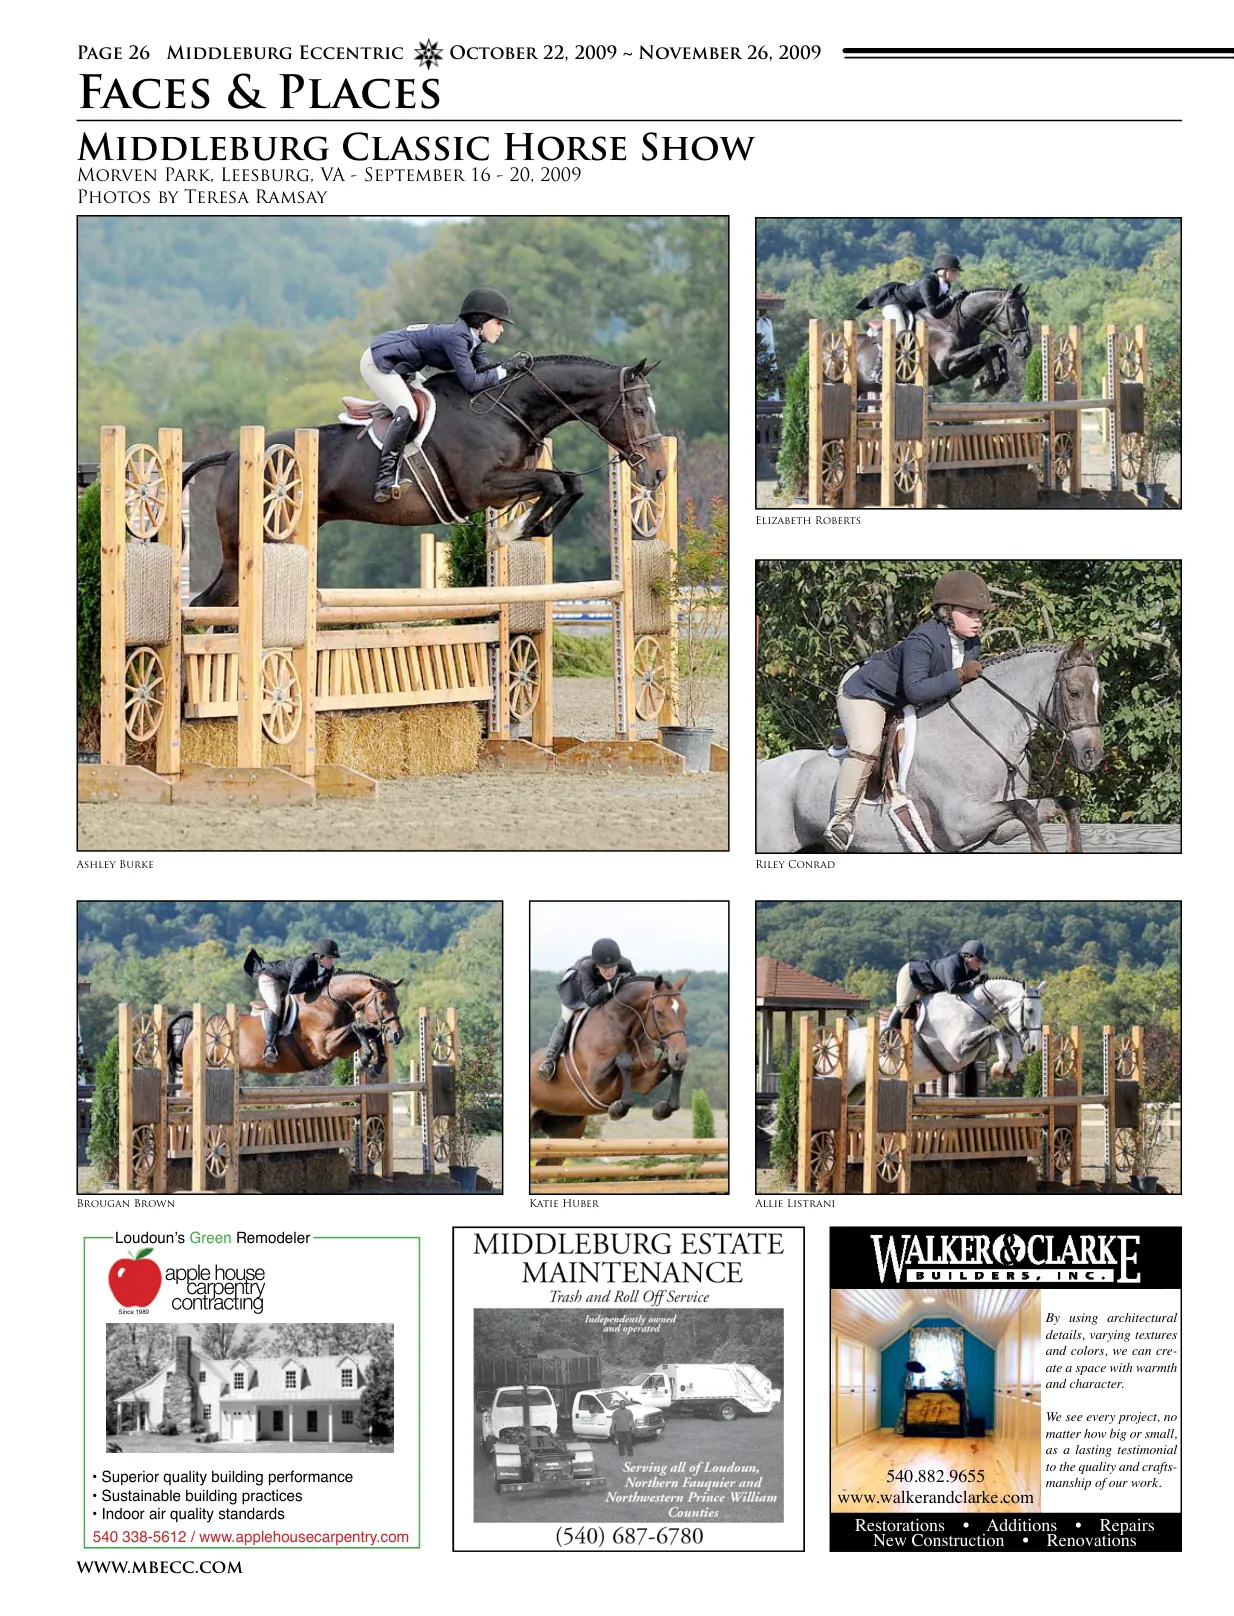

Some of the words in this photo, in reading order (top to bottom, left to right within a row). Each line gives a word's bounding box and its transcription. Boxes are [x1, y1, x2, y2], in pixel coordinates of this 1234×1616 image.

[77, 44, 123, 60] PAGE
[128, 44, 151, 60] 26
[166, 44, 293, 60] MIDDLEBURG
[299, 44, 404, 60] ECCENTRIC
[449, 44, 539, 60] OCTOBER
[542, 44, 569, 62] 22,
[574, 44, 618, 60] 2009
[638, 44, 743, 60] NOVEMBER
[746, 44, 773, 62] 26,
[778, 44, 822, 60] 2009
[78, 73, 210, 110] FACES
[227, 72, 268, 110] &
[278, 73, 440, 110] PLACES
[76, 131, 330, 162] MIDDLEBURG
[342, 131, 490, 162] CLASSIC
[503, 132, 627, 162] HORSE
[641, 131, 756, 162] SHOW
[77, 166, 157, 182] MORVEN
[165, 166, 214, 183] PARK,
[221, 166, 314, 183] LEESBURG,
[319, 166, 346, 182] VA
[364, 166, 466, 182] SEPTEMBER
[471, 166, 491, 182] 16
[509, 166, 534, 183] 20,
[540, 166, 582, 182] 2009
[78, 188, 151, 204] PHOTOS
[158, 190, 179, 204] BY
[183, 188, 250, 204] TERESA
[256, 188, 328, 204] RAMSAY
[756, 515, 811, 525] ELIZABETH
[815, 515, 861, 525] ROBERTS
[76, 859, 116, 869] ASHLEY
[119, 859, 154, 869] BURKE
[756, 859, 786, 869] RILEY
[788, 859, 836, 869] CONRAD
[77, 1198, 130, 1208] BROUGAN
[134, 1198, 175, 1208] BROWN
[529, 1198, 559, 1208] KATIE
[563, 1198, 600, 1208] HUBER
[755, 1198, 784, 1208] ALLIE
[787, 1198, 835, 1208] LISTRANI
[115, 1231, 186, 1244] Loudoun's
[189, 1231, 232, 1244] Green
[236, 1231, 311, 1244] Remodeler
[472, 1232, 672, 1255] MIDDLEBURG
[680, 1232, 785, 1255] ESTATE
[165, 1264, 211, 1284] apple
[215, 1264, 265, 1281] house
[521, 1261, 744, 1284] MAINTENANCE
[915, 1271, 1041, 1282] BUILDERS,
[1057, 1271, 1106, 1281] INC.
[186, 1280, 266, 1299] carpentry
[171, 1295, 264, 1314] contracting
[550, 1290, 582, 1303] Trash
[585, 1290, 611, 1303] and
[613, 1290, 640, 1303] Roll
[643, 1290, 667, 1307] Off
[666, 1290, 710, 1303] Service
[1045, 1312, 1061, 1326] By
[1068, 1312, 1099, 1326] using
[1106, 1312, 1178, 1323] architectural
[622, 1462, 668, 1476] Serving
[670, 1462, 685, 1473] all
[689, 1462, 703, 1476] of
[704, 1462, 760, 1474] Loudoun,
[886, 1469, 985, 1483] 540.882.9655
[101, 1469, 160, 1486] Superior
[163, 1470, 208, 1487] quality
[211, 1470, 264, 1487] building
[268, 1469, 354, 1486] performance
[101, 1488, 181, 1503] Sustainable
[185, 1489, 238, 1505] building
[241, 1489, 303, 1505] practices
[837, 1490, 1034, 1504] www.walkerandclarke.com
[102, 1507, 146, 1521] Indoor
[148, 1507, 167, 1520] air
[169, 1507, 215, 1524] quality
[218, 1507, 285, 1521] standards
[855, 1518, 945, 1532] Restorations
[986, 1518, 1058, 1532] Additions
[1099, 1518, 1155, 1535] Repairs
[92, 1530, 119, 1543] 540
[121, 1530, 187, 1544] 338-5612
[198, 1530, 409, 1546] www.applehousecarpentry.com
[556, 1525, 605, 1548] (540)
[612, 1526, 704, 1546] 687-6780
